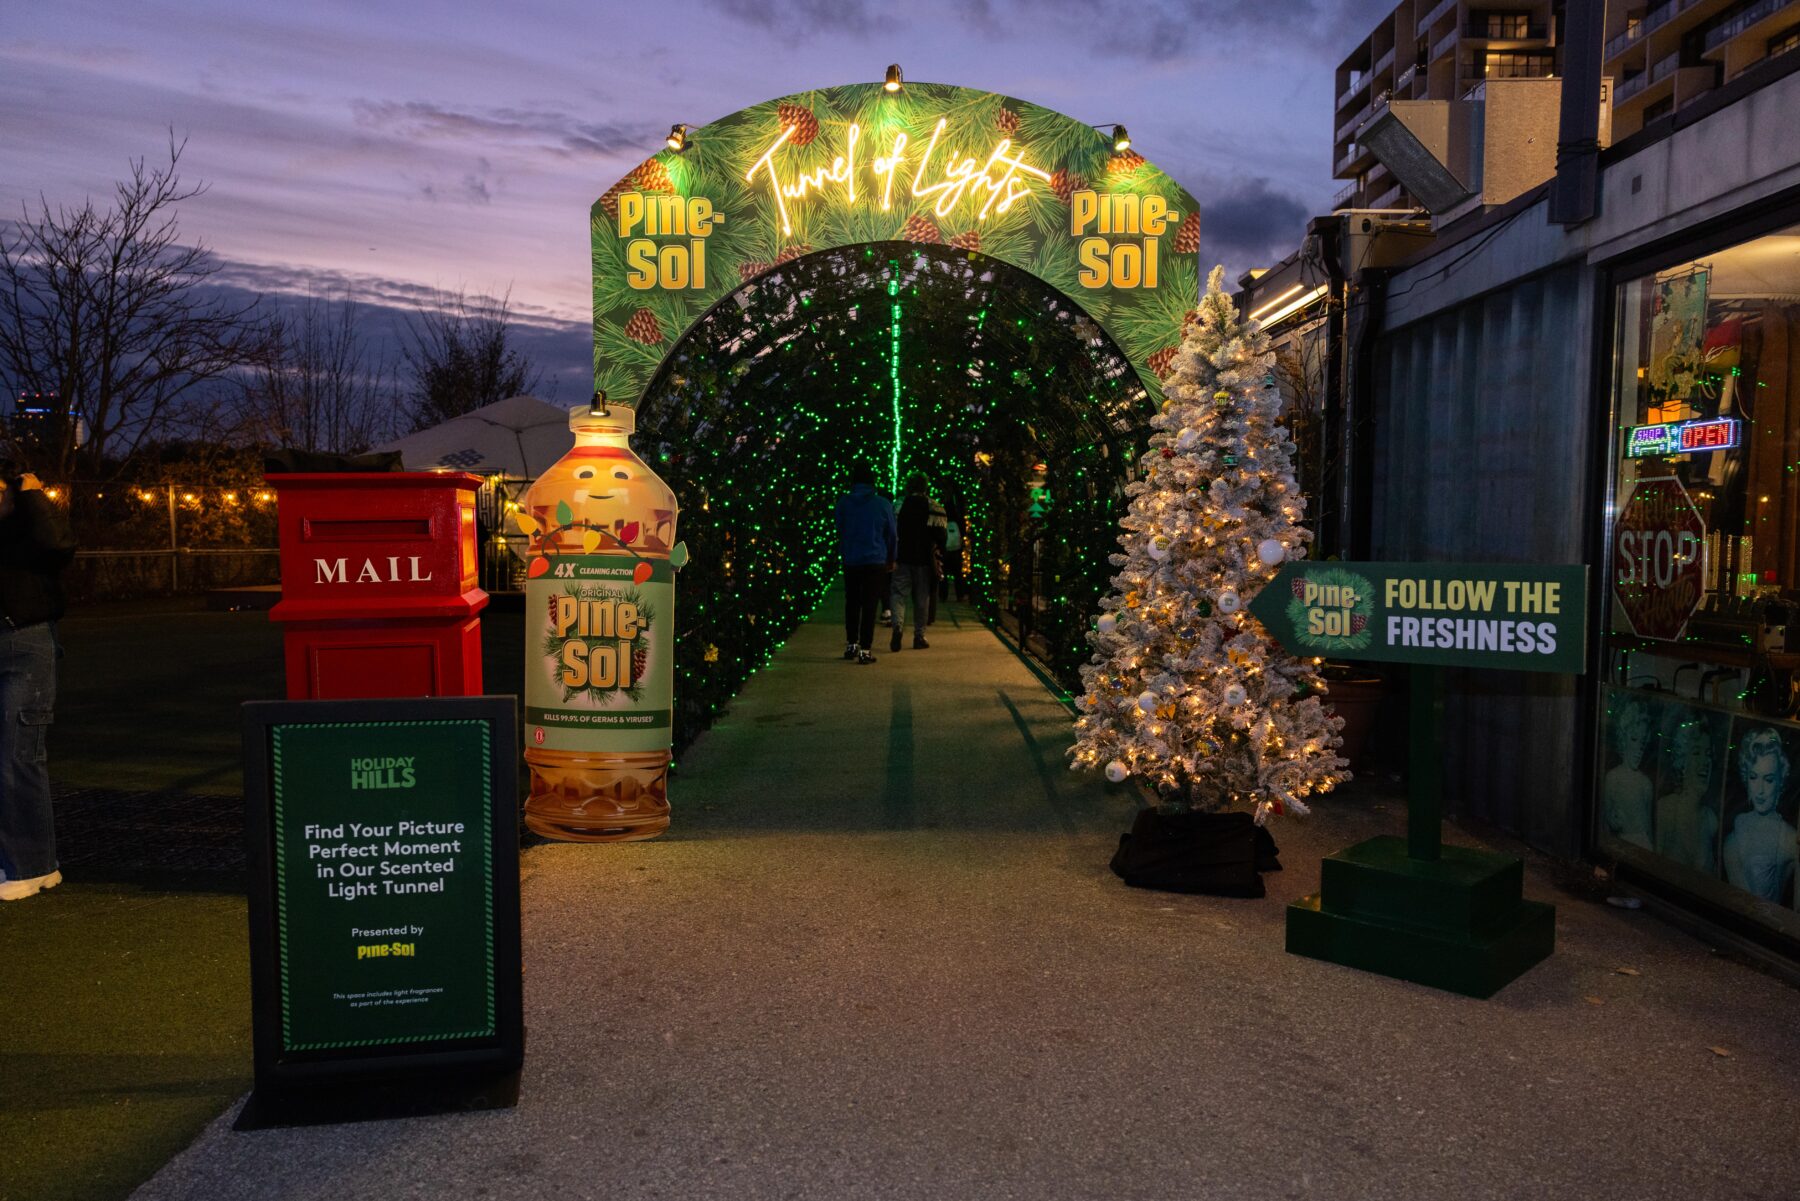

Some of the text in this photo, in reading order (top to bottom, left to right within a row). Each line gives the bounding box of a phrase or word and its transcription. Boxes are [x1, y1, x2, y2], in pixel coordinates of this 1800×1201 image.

[746, 118, 1052, 236] Tunnel of Lights
[618, 191, 725, 238] Pine-
[1071, 189, 1179, 237] Pine-
[627, 238, 705, 290] Sol
[1078, 236, 1158, 288] Sol
[1637, 423, 1728, 448] SHOP OPEN
[313, 556, 432, 584] MAIL
[579, 567, 610, 576] CLEANING
[610, 568, 634, 577] ACTION
[1618, 529, 1697, 590] STOP
[580, 589, 622, 598] ORIGINAL
[1303, 583, 1361, 608] Pine-
[1385, 578, 1561, 614] FOLLOW THE
[557, 594, 647, 640] Pine-
[1307, 607, 1351, 637] Sol
[1387, 616, 1557, 655] FRESHNESS
[562, 638, 631, 688] Sol
[543, 713, 560, 721] KILLS
[560, 714, 579, 722] 99.9%
[579, 715, 591, 723] OF
[351, 756, 415, 771] HOLIDAY
[351, 767, 417, 790] HILLS
[304, 820, 464, 839] Find Your Picture
[309, 839, 461, 859] Perfect Moment
[317, 858, 454, 878] in Our Scented
[328, 877, 444, 901] Light Tunnel
[351, 924, 424, 937] Presented by
[347, 992, 365, 1000] space
[366, 990, 393, 998] includes
[393, 989, 409, 997] light
[409, 987, 444, 996] fragrances
[358, 1000, 373, 1009] part
[395, 997, 429, 1005] experience
